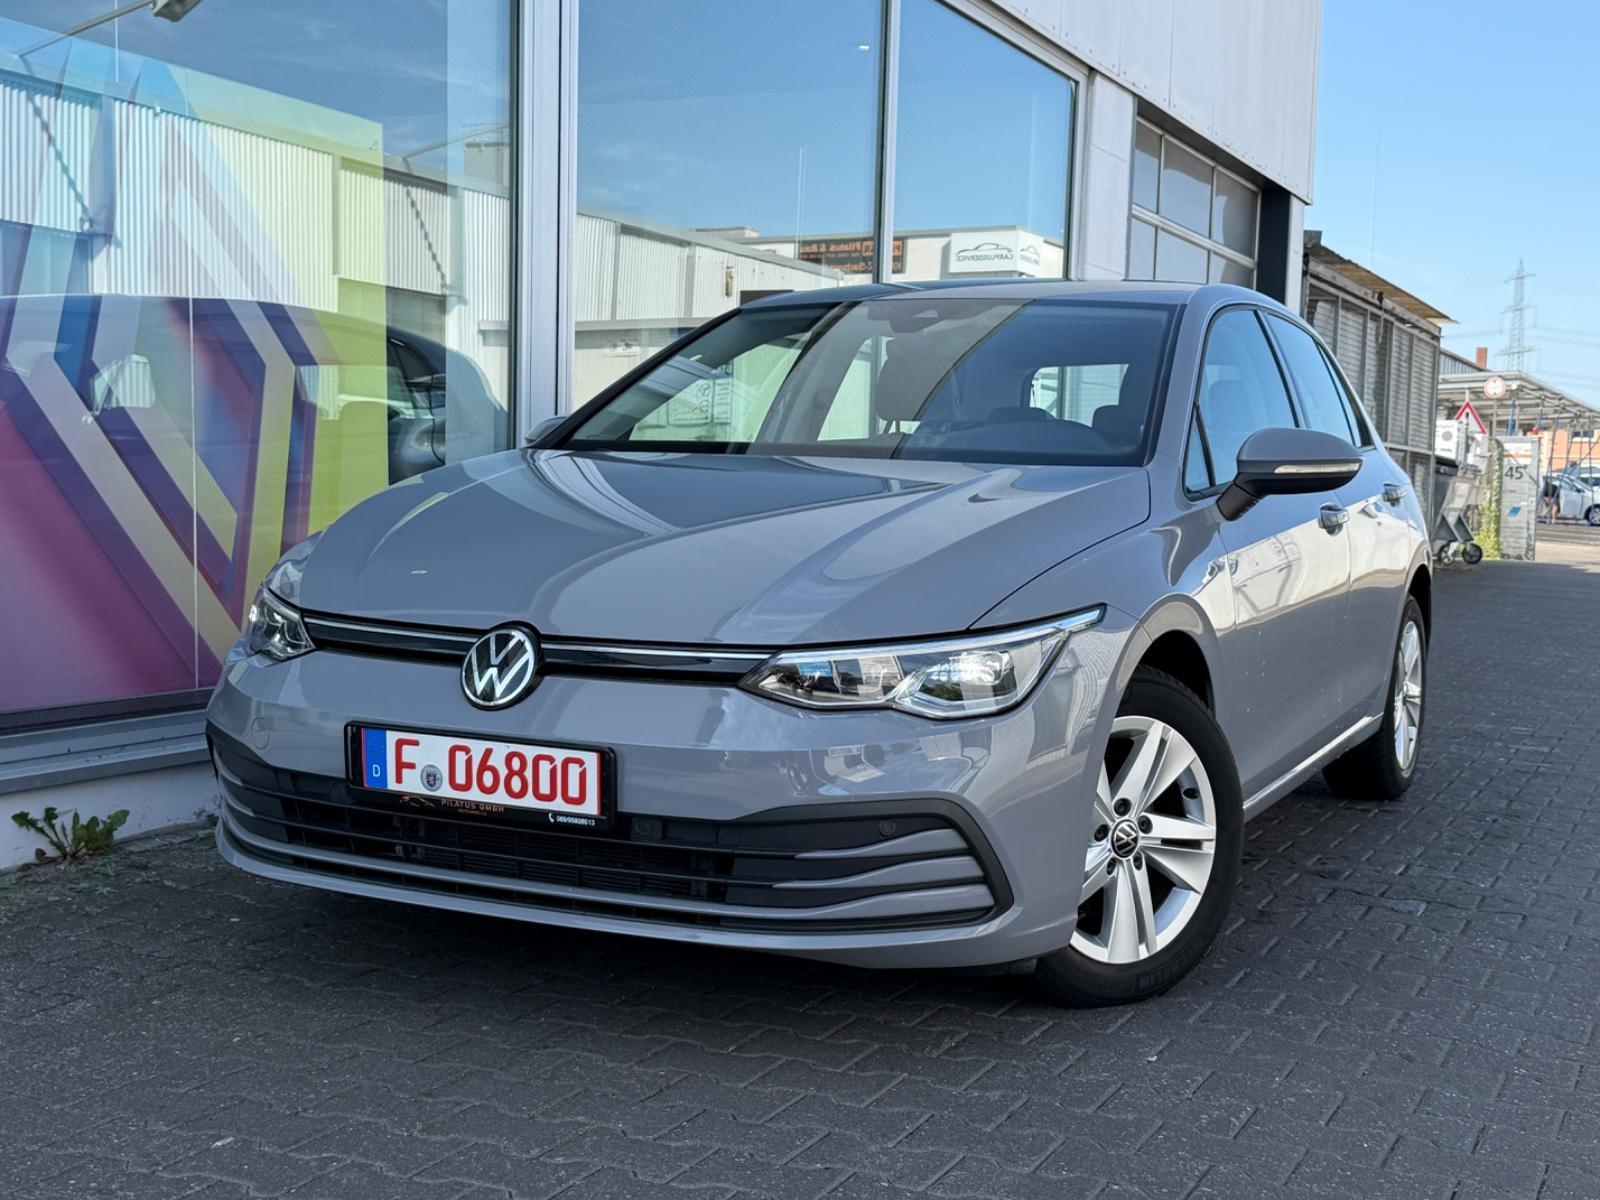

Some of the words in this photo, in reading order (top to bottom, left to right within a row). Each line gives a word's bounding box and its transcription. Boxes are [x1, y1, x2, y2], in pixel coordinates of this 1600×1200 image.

[1505, 466, 1523, 480] 45
[372, 763, 381, 778] D
[395, 737, 420, 785] F
[448, 744, 587, 806] 06800
